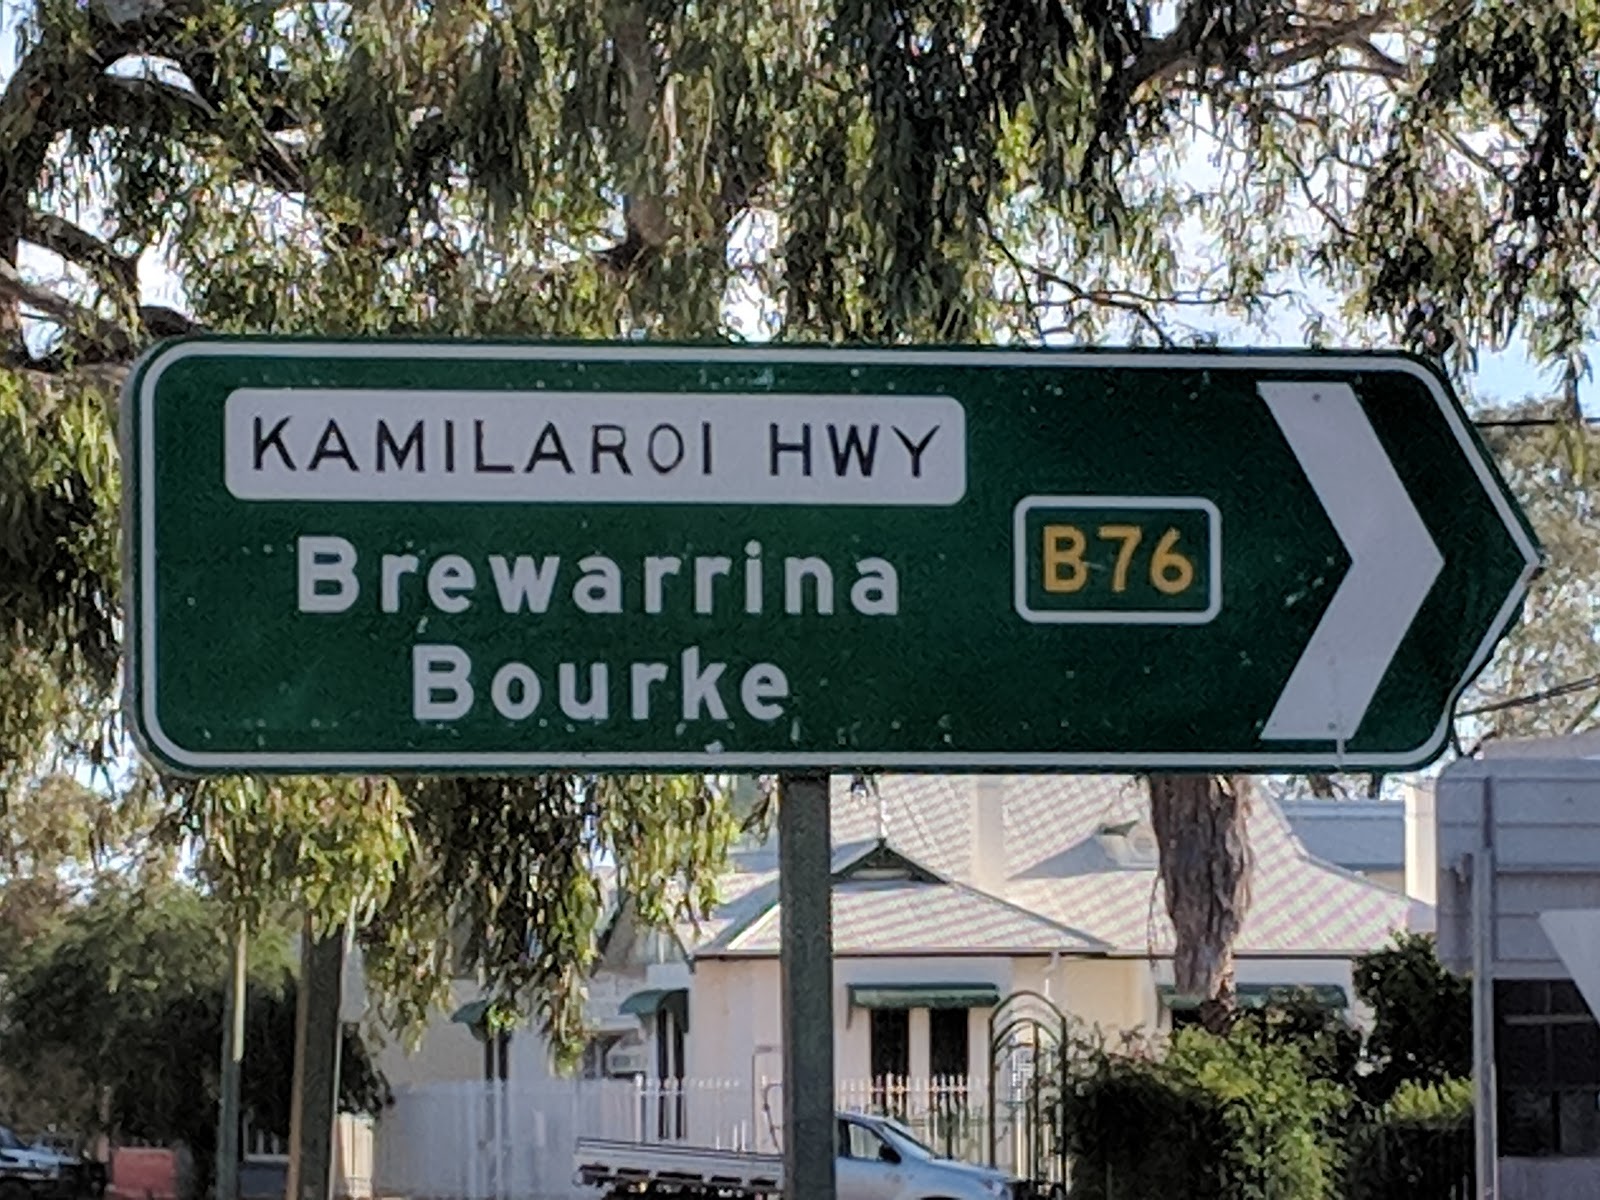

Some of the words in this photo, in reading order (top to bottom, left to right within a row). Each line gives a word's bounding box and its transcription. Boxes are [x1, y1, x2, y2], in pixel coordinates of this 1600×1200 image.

[252, 415, 713, 476] KAMILAROI
[769, 422, 941, 478] HWY
[297, 536, 898, 615] Brewarrina
[1042, 525, 1194, 593] B76
[413, 645, 790, 721] Bourke
